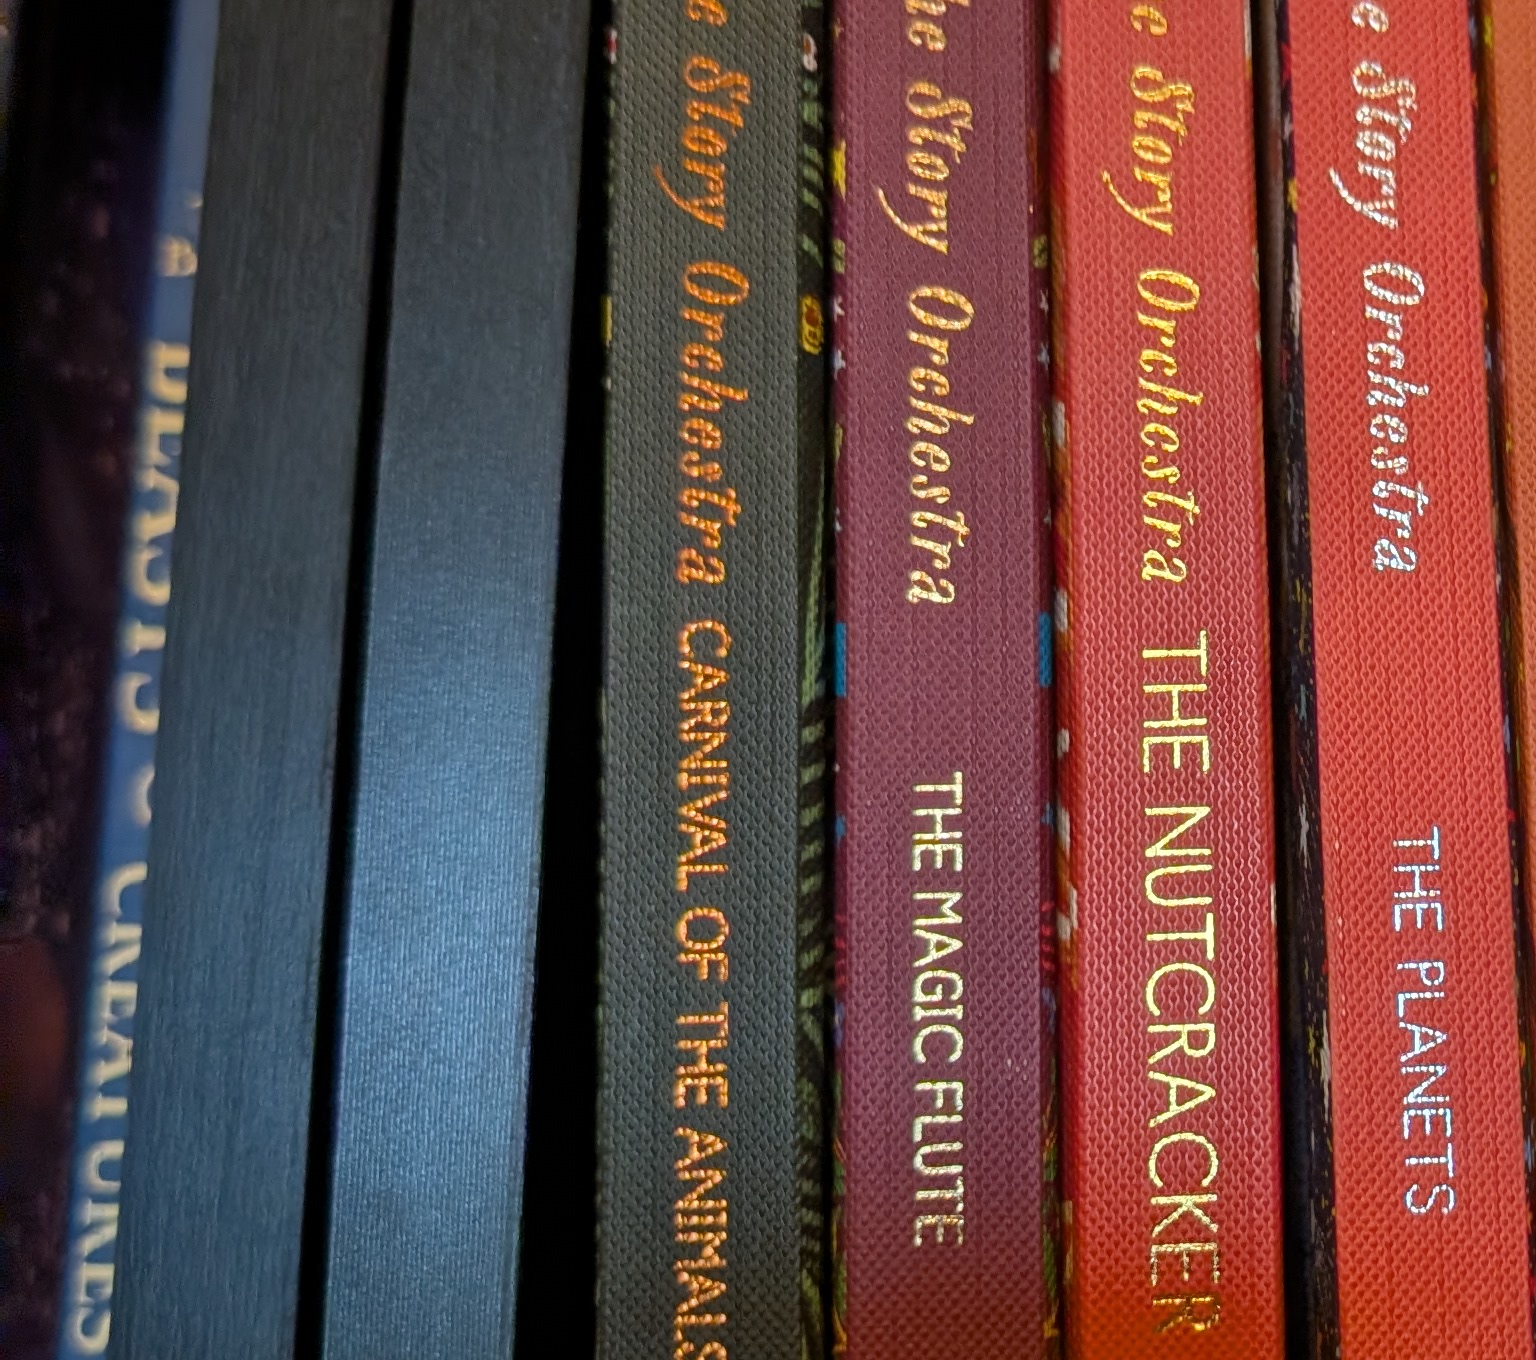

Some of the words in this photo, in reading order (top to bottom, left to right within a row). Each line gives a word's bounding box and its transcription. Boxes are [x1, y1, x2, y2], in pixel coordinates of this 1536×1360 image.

[652, 54, 752, 231] Story
[876, 80, 974, 255] Story
[1102, 65, 1197, 234] Story
[1329, 61, 1419, 231] Story
[675, 259, 751, 586] Orchestra
[905, 284, 977, 607] Orchestra
[1135, 268, 1203, 584] Orchestra
[1363, 261, 1431, 574] Orchestra
[675, 618, 732, 892] CARNIVAL
[1142, 630, 1210, 774] THE
[911, 771, 963, 875] THE
[1392, 826, 1445, 932] THE
[675, 906, 730, 983] OF
[911, 891, 965, 1064] MAGIC
[673, 1001, 730, 1110] THE
[1143, 805, 1223, 1333] NUTCRACKER
[1395, 958, 1457, 1216] PLANETS
[913, 1079, 965, 1248] FLUTE
